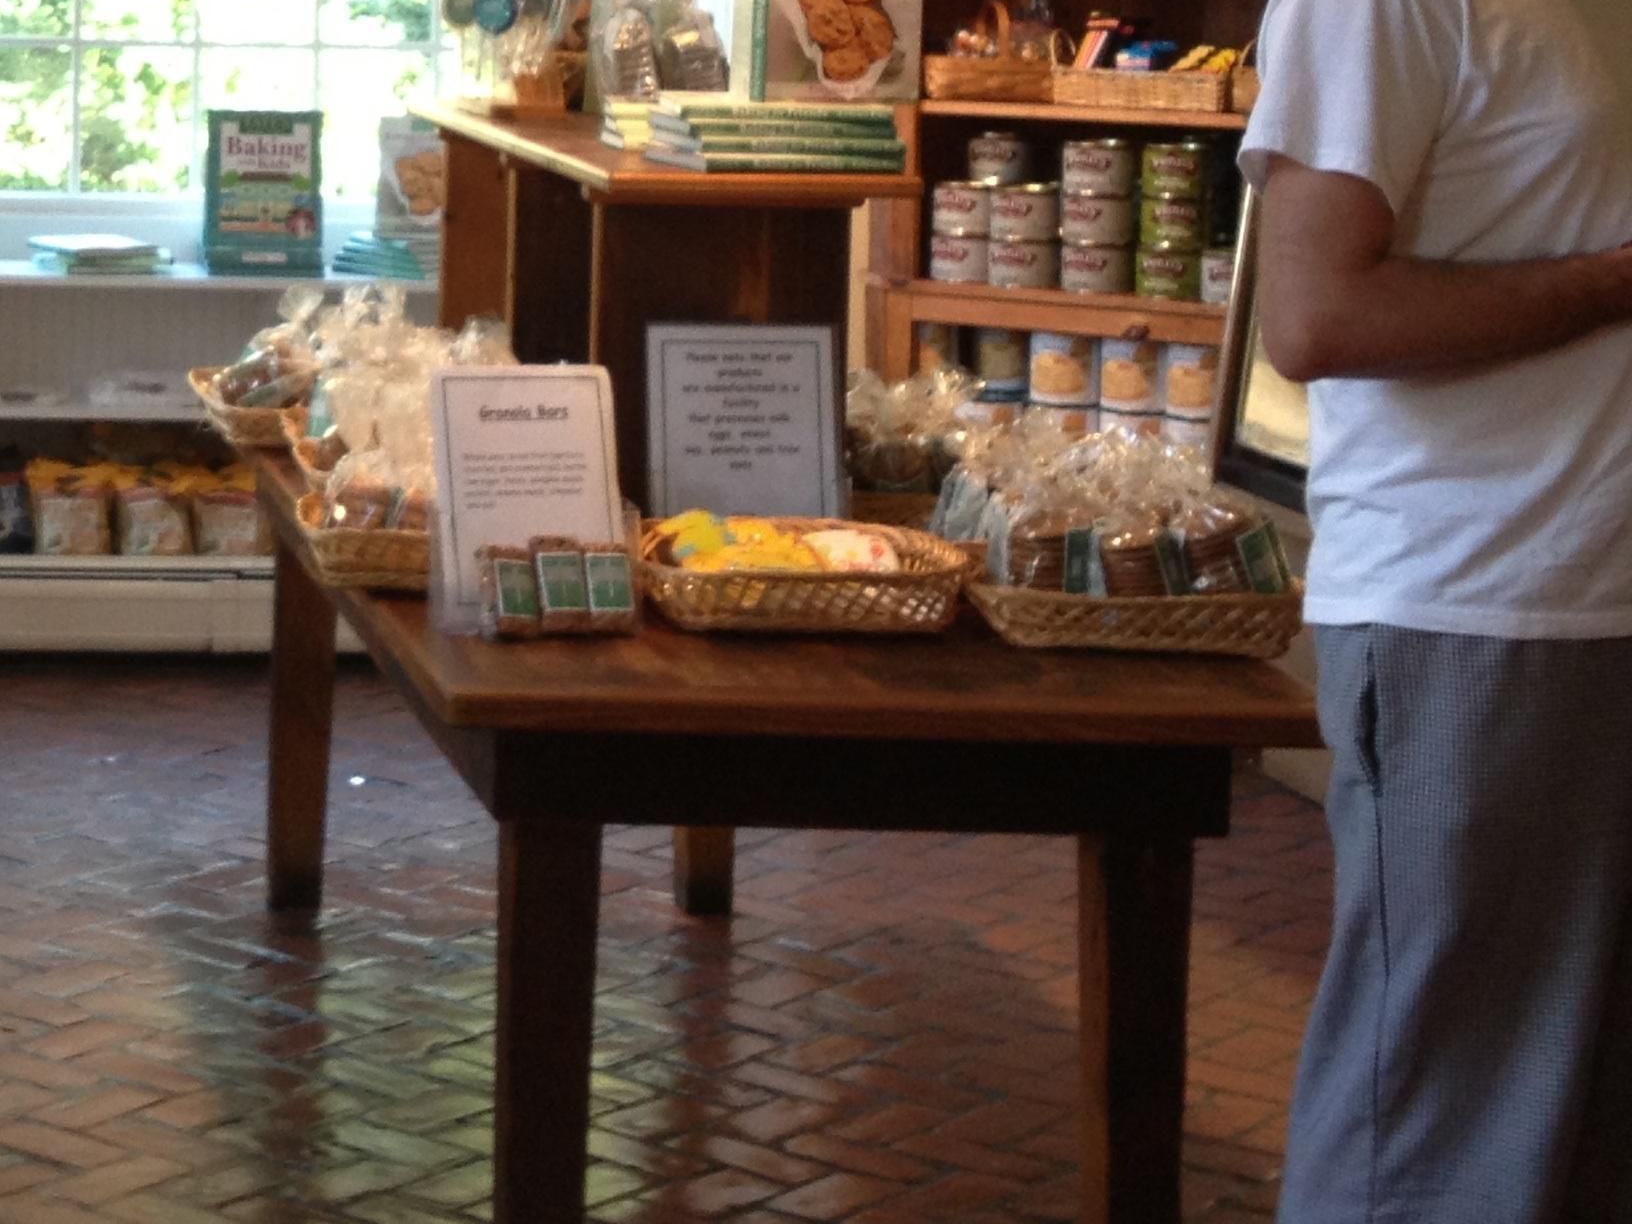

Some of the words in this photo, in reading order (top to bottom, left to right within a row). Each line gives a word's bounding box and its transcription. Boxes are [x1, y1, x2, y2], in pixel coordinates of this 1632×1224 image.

[228, 136, 306, 162] Baking
[478, 404, 532, 418] Granola
[536, 404, 568, 418] Bars
